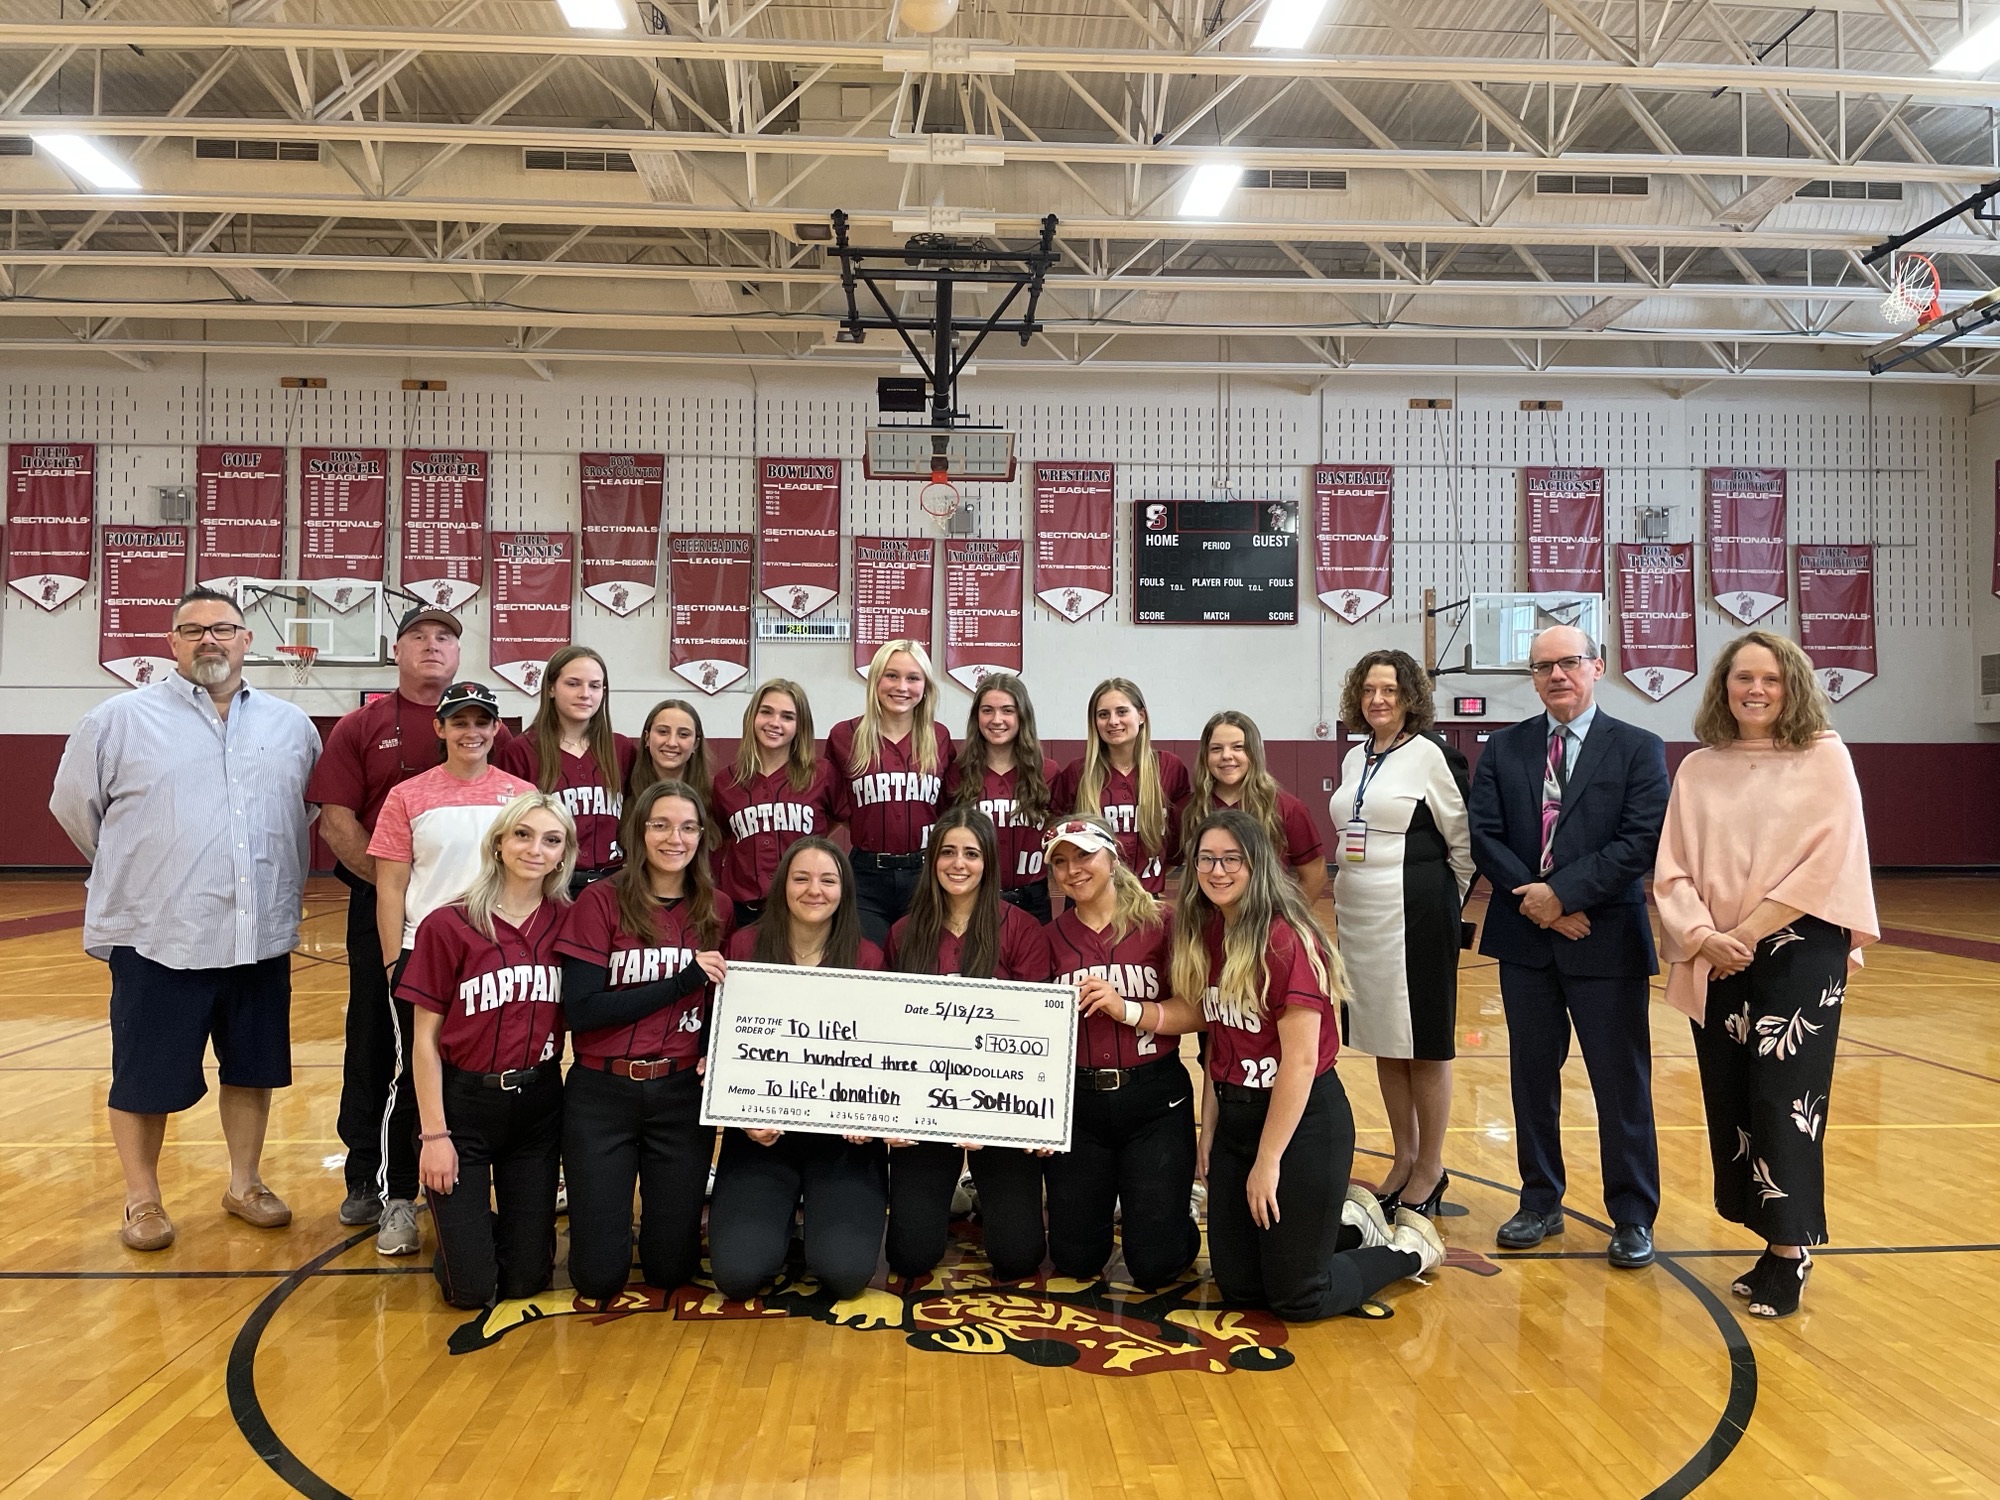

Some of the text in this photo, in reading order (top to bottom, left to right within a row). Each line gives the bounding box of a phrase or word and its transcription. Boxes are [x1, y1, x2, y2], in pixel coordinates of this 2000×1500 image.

[34, 447, 69, 457] FIELD
[330, 451, 361, 461] BOYS
[21, 455, 83, 468] HOCKEY
[222, 453, 261, 467] GOLF
[430, 454, 463, 463] GIRLS
[610, 456, 634, 466] BOYS
[310, 459, 380, 474] SOCCER
[412, 461, 479, 476] SOCCER
[583, 466, 661, 478] CROSS COUNTRY
[767, 464, 833, 479] BOWLING
[422, 475, 468, 483] LEAGUE
[1038, 469, 1110, 482] WRESTLING
[1317, 472, 1389, 485] BASEBALL
[1550, 470, 1580, 480] GIRLS
[1733, 470, 1761, 480] BOYS
[600, 478, 645, 486] LEAGUE
[778, 483, 824, 491] LEAGUE
[1530, 478, 1600, 492] LACROSSE
[1712, 480, 1781, 492] OUTDOOR TRACK
[306, 520, 381, 528] SECTIONALS
[765, 528, 836, 537] SECTIONALS
[1040, 532, 1108, 540] SECTIONALS
[105, 532, 183, 547] FOOTBALL
[515, 535, 549, 544] GIRLS
[881, 540, 908, 550] BOYS
[1146, 535, 1179, 546] HOME
[1253, 535, 1290, 547] GUEST
[500, 542, 563, 558] TENNIS
[673, 539, 749, 553] CHEERLEADING
[966, 542, 998, 552] GIRLS
[1203, 542, 1230, 550] PERIOD
[1643, 546, 1670, 555] BOYS
[858, 547, 930, 562] INDOOR TRACK
[948, 550, 1019, 563] INDOOR TRACK
[872, 562, 917, 570] LEAGUE
[1628, 554, 1684, 568] TENNIS
[1140, 578, 1164, 586] FOULS
[1192, 578, 1243, 586] PLAYER FOUL
[1269, 579, 1294, 587] FOULS
[107, 598, 181, 606] SECTIONALS
[676, 604, 748, 612] SECTIONALS
[859, 607, 928, 615] SECTIONALS
[1140, 612, 1165, 620] SCORE
[1204, 612, 1230, 620] MATCH
[1269, 612, 1294, 620] SCORE
[852, 772, 941, 808] TARTANS
[729, 803, 814, 844] TARTANS
[921, 824, 936, 848] 1
[1017, 851, 1043, 874] 10
[609, 947, 693, 986] TARTA
[460, 965, 562, 1016] TARTAN
[904, 1004, 929, 1015] Date
[1044, 1000, 1064, 1008] 1001
[936, 1002, 994, 1024] 5/18/23
[736, 1016, 782, 1026] PAY TO THE
[735, 1026, 776, 1035] ORDER OF
[820, 1020, 858, 1040] life!
[974, 1035, 983, 1050] $
[988, 1036, 1044, 1056] 703.00
[1136, 1030, 1157, 1056] 2
[738, 1043, 972, 1081] Seven hundred three 00/100
[973, 1068, 1024, 1080] DOLLARS
[1241, 1057, 1278, 1088] 22
[728, 1085, 756, 1096] Memo
[766, 1078, 900, 1105] To life! donation
